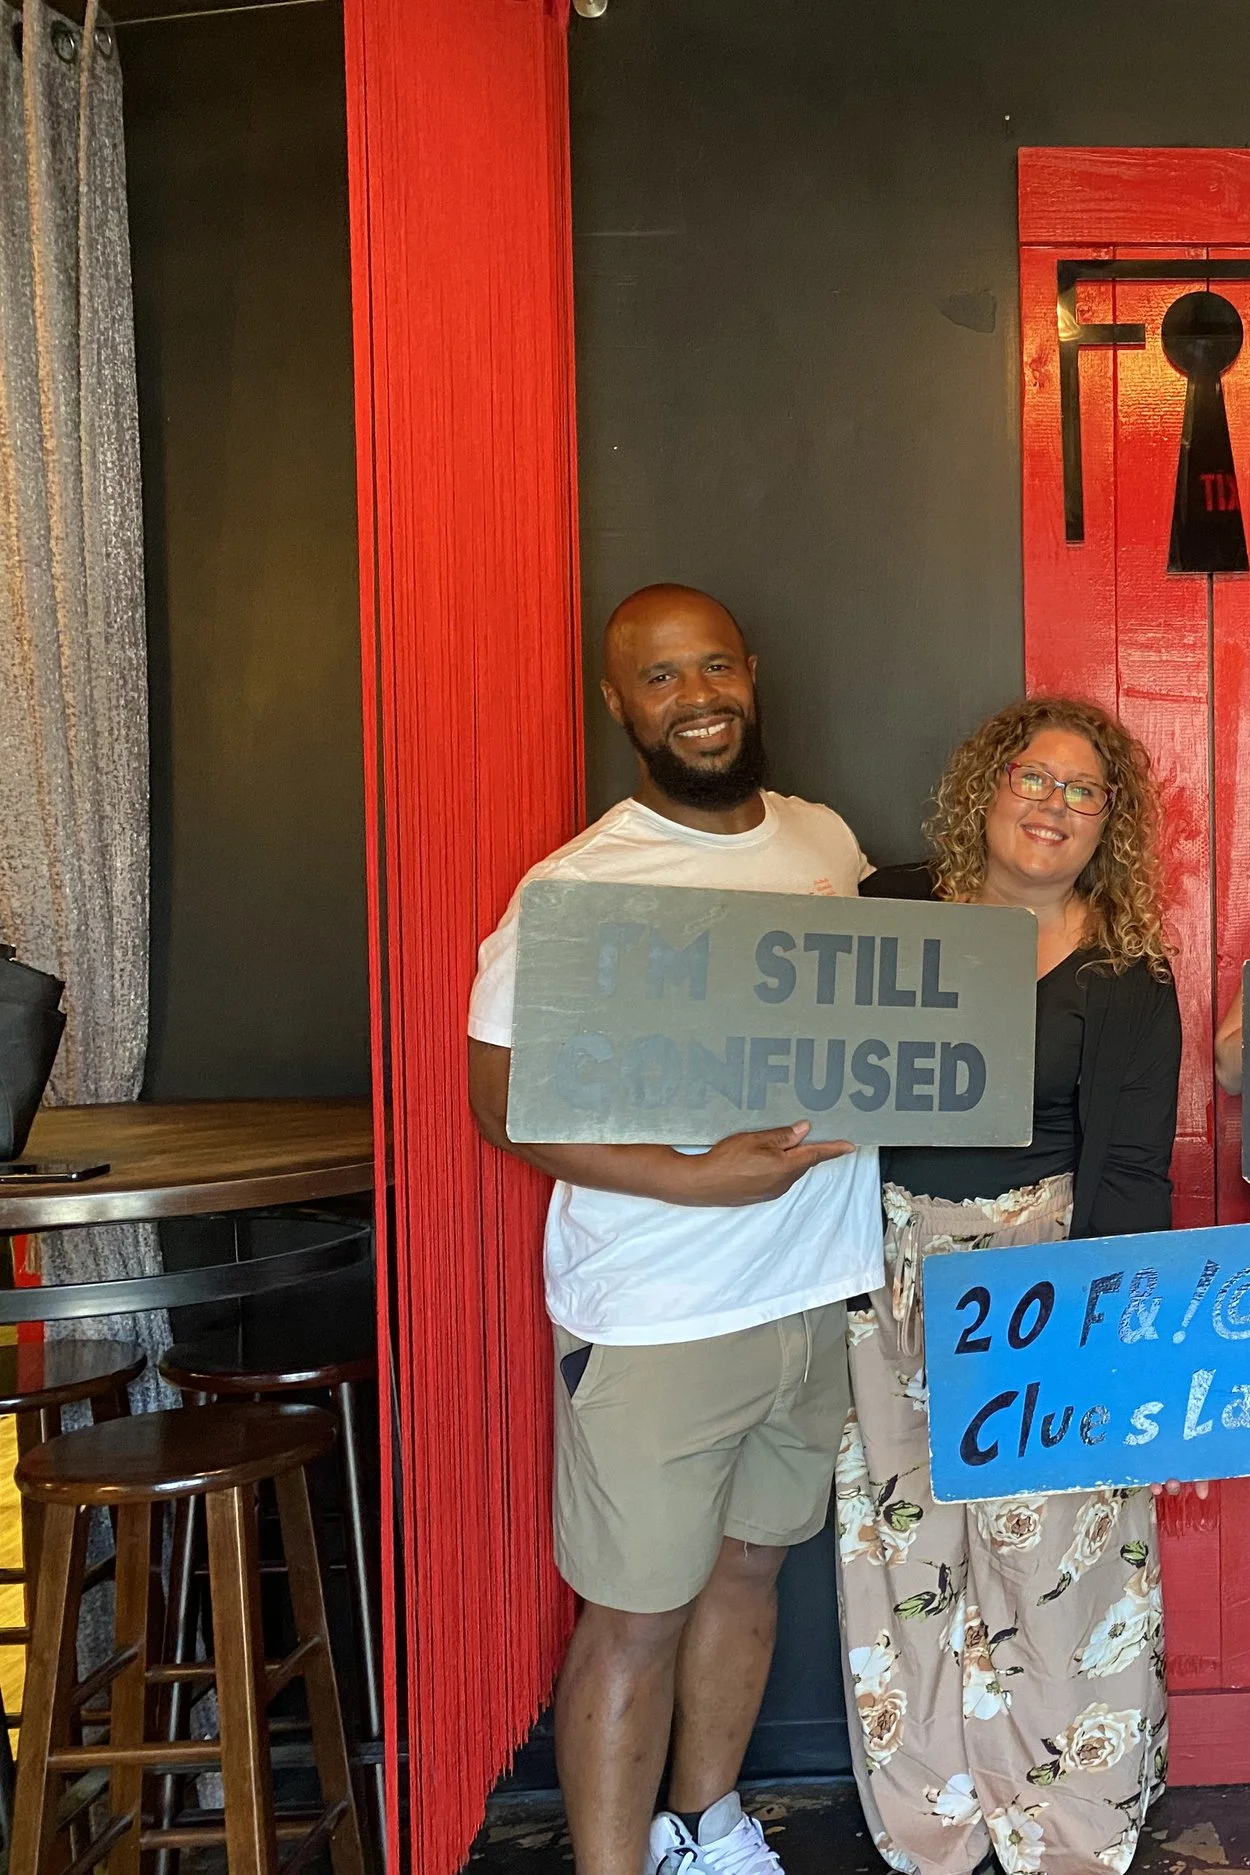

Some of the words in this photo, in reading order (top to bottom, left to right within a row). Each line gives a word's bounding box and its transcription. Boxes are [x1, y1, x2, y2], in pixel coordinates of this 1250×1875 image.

[598, 922, 710, 1000] I'M
[753, 930, 960, 1009] STILL
[555, 1033, 988, 1113] CONFUSED
[954, 1280, 1056, 1356] 20
